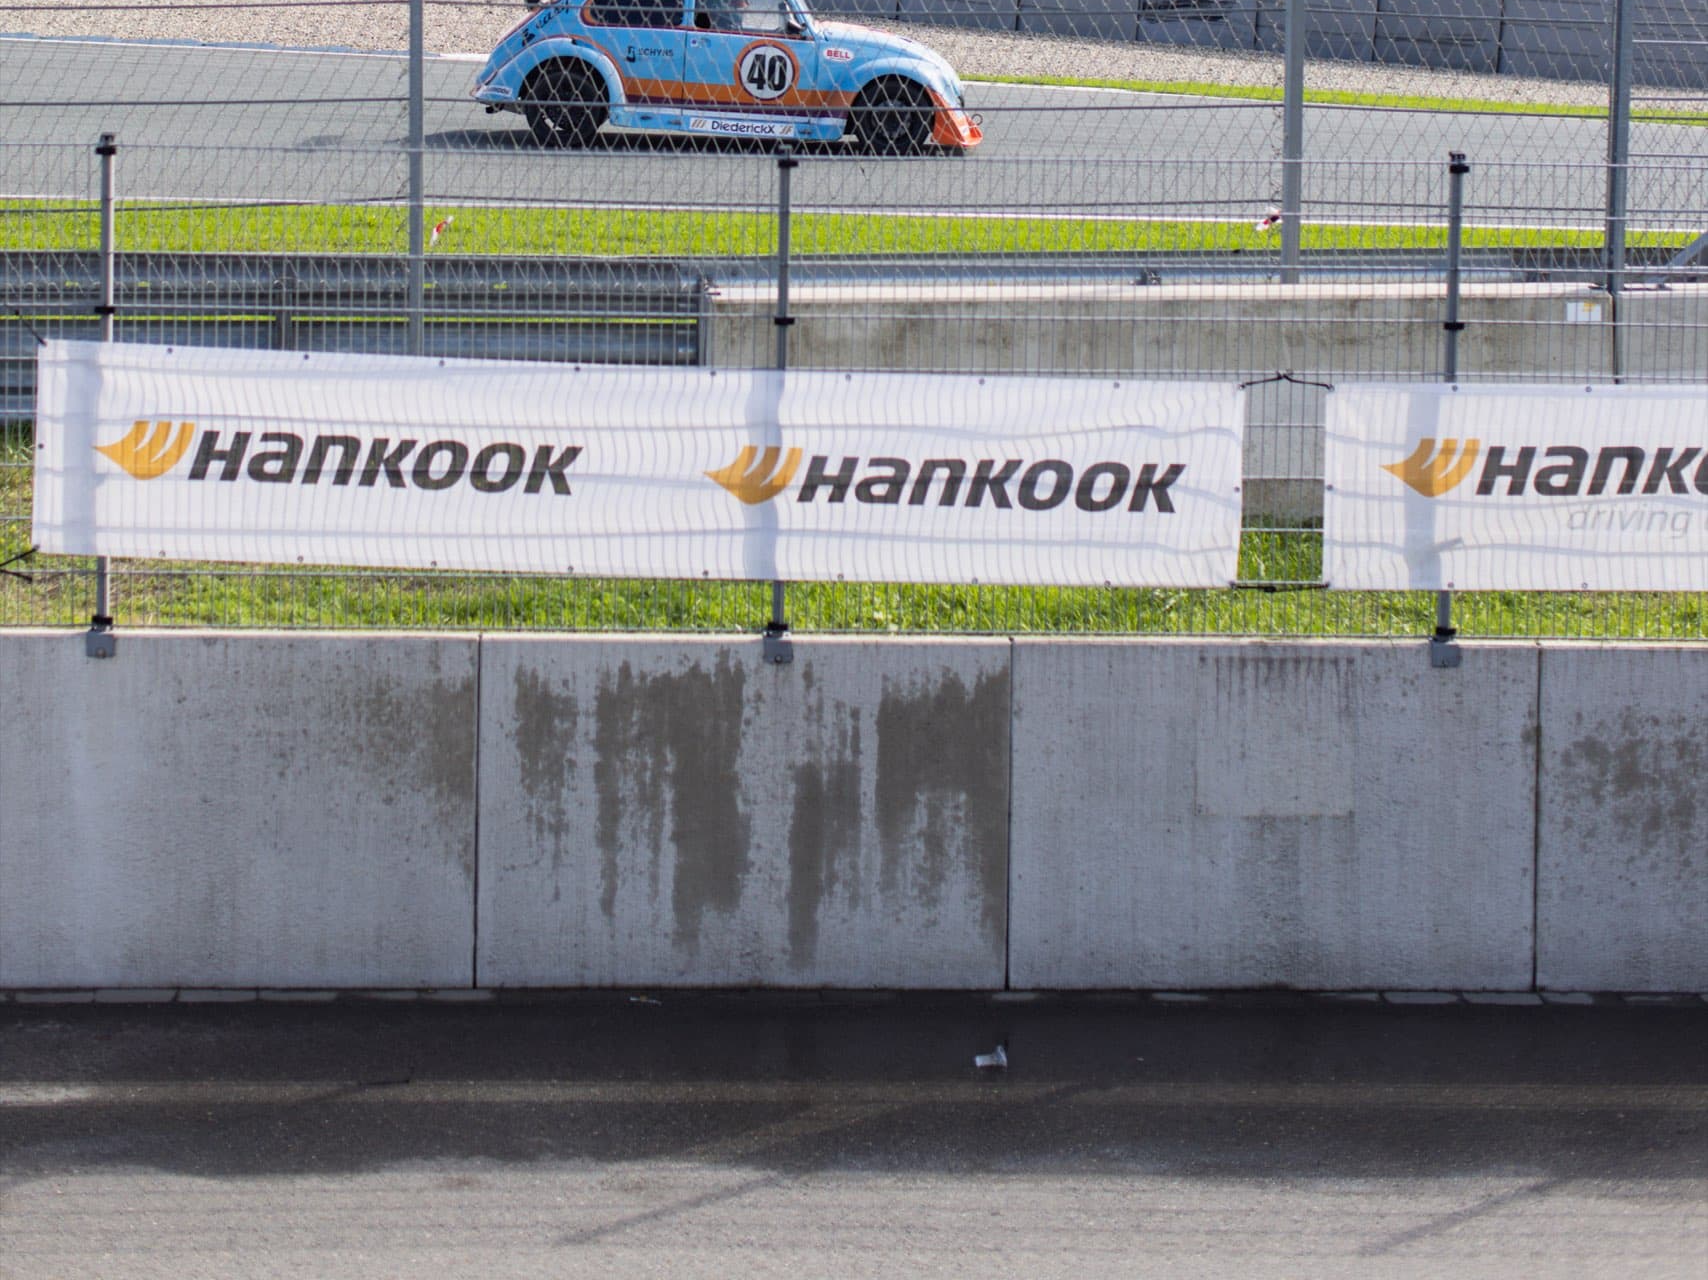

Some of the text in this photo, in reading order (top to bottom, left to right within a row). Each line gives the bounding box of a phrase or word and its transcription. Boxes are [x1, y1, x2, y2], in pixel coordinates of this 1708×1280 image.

[826, 49, 851, 59] BELL
[746, 53, 788, 91] 40
[711, 120, 775, 134] DiederickX
[1475, 445, 1708, 496] HanK
[1567, 503, 1694, 538] driving
